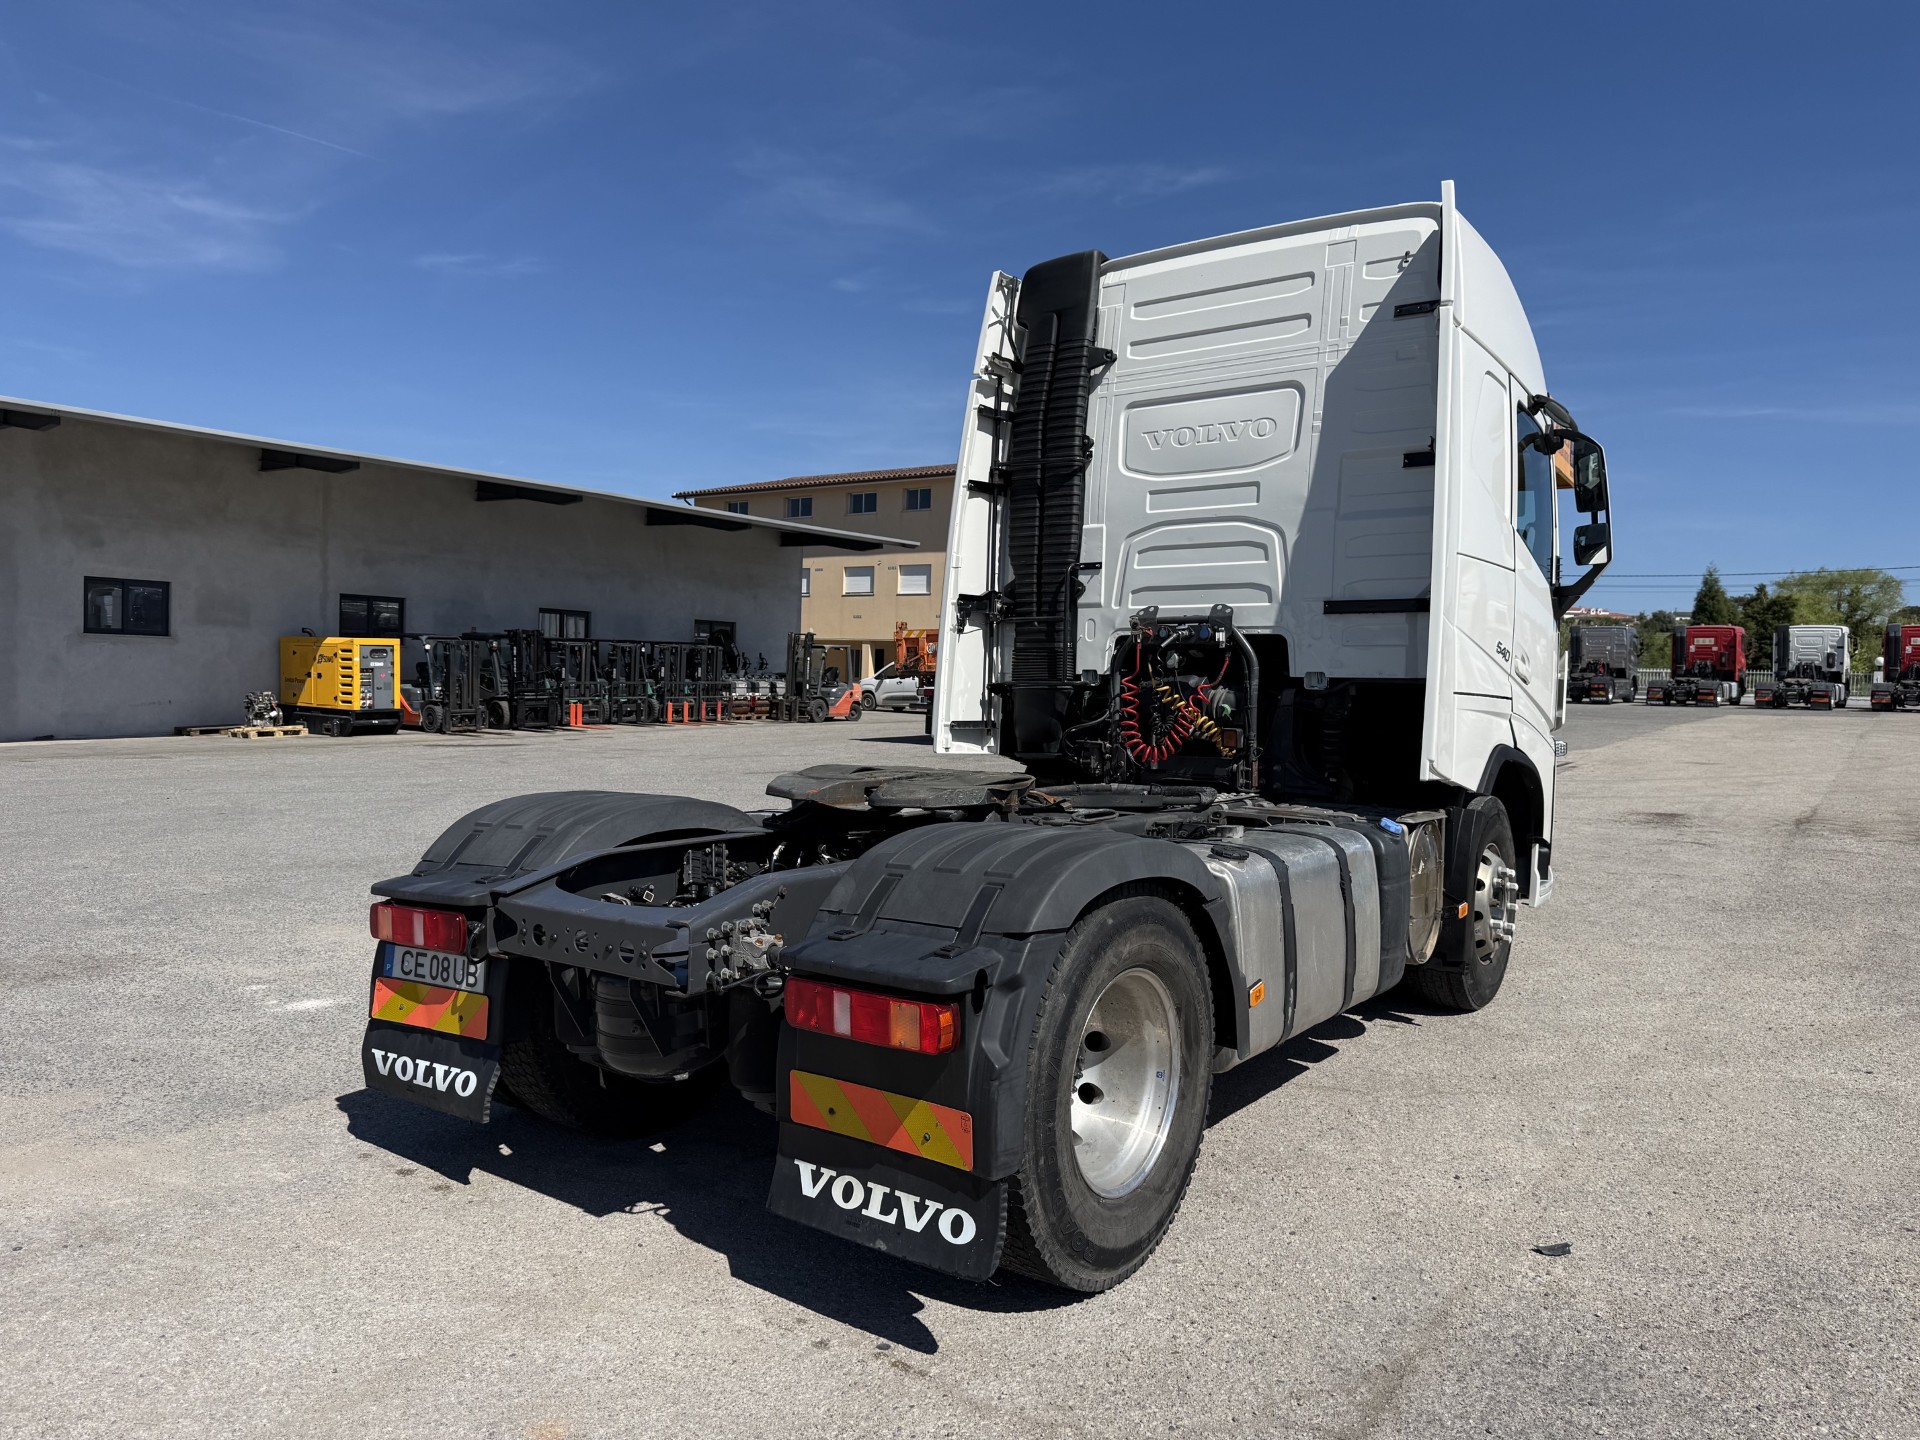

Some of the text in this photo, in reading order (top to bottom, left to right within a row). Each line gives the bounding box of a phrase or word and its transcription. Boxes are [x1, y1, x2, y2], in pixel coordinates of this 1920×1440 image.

[1141, 417, 1277, 451] VOLVO
[1495, 640, 1511, 663] 540
[371, 1047, 478, 1098] VOLVO
[793, 1158, 977, 1245] VOLVO
